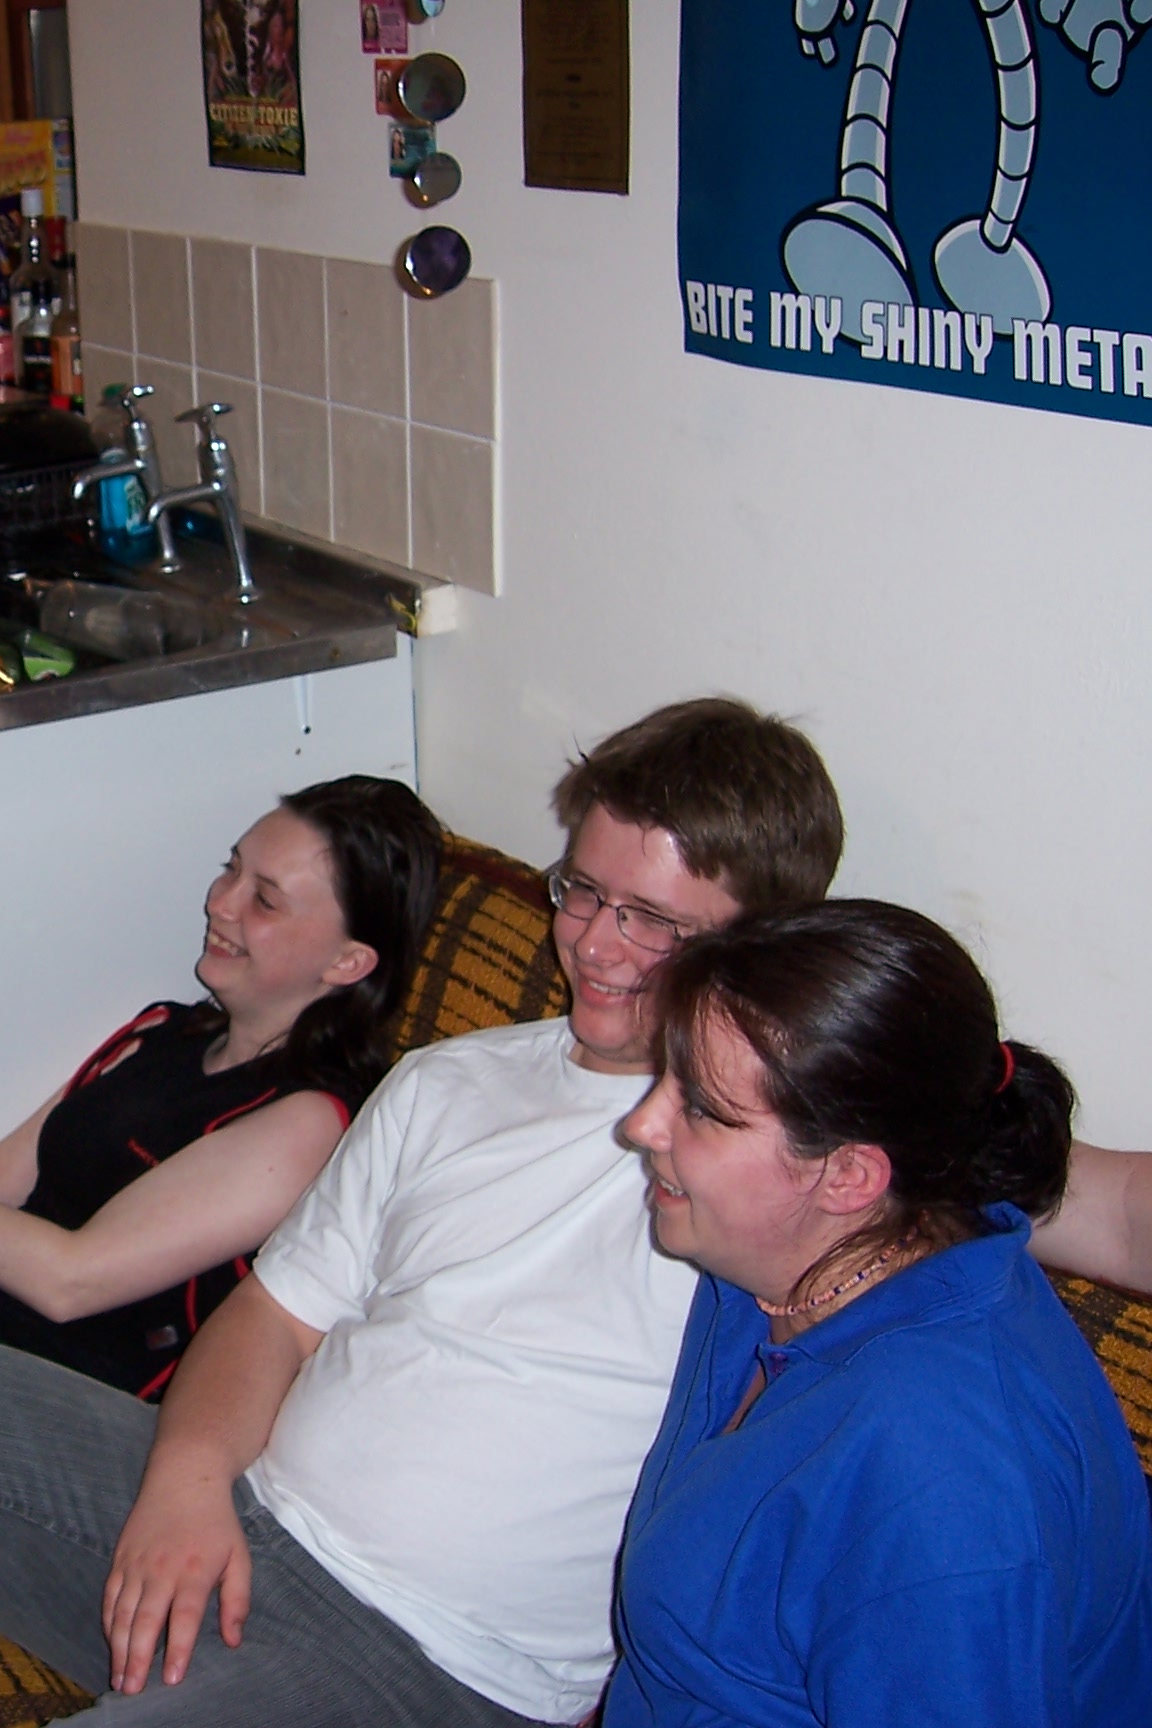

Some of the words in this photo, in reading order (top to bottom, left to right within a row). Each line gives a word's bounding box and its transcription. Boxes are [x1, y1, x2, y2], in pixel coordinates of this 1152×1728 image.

[258, 106, 298, 127] TOXIE
[685, 280, 753, 345] BITE
[769, 290, 843, 354] MY
[860, 300, 994, 375] SHINY
